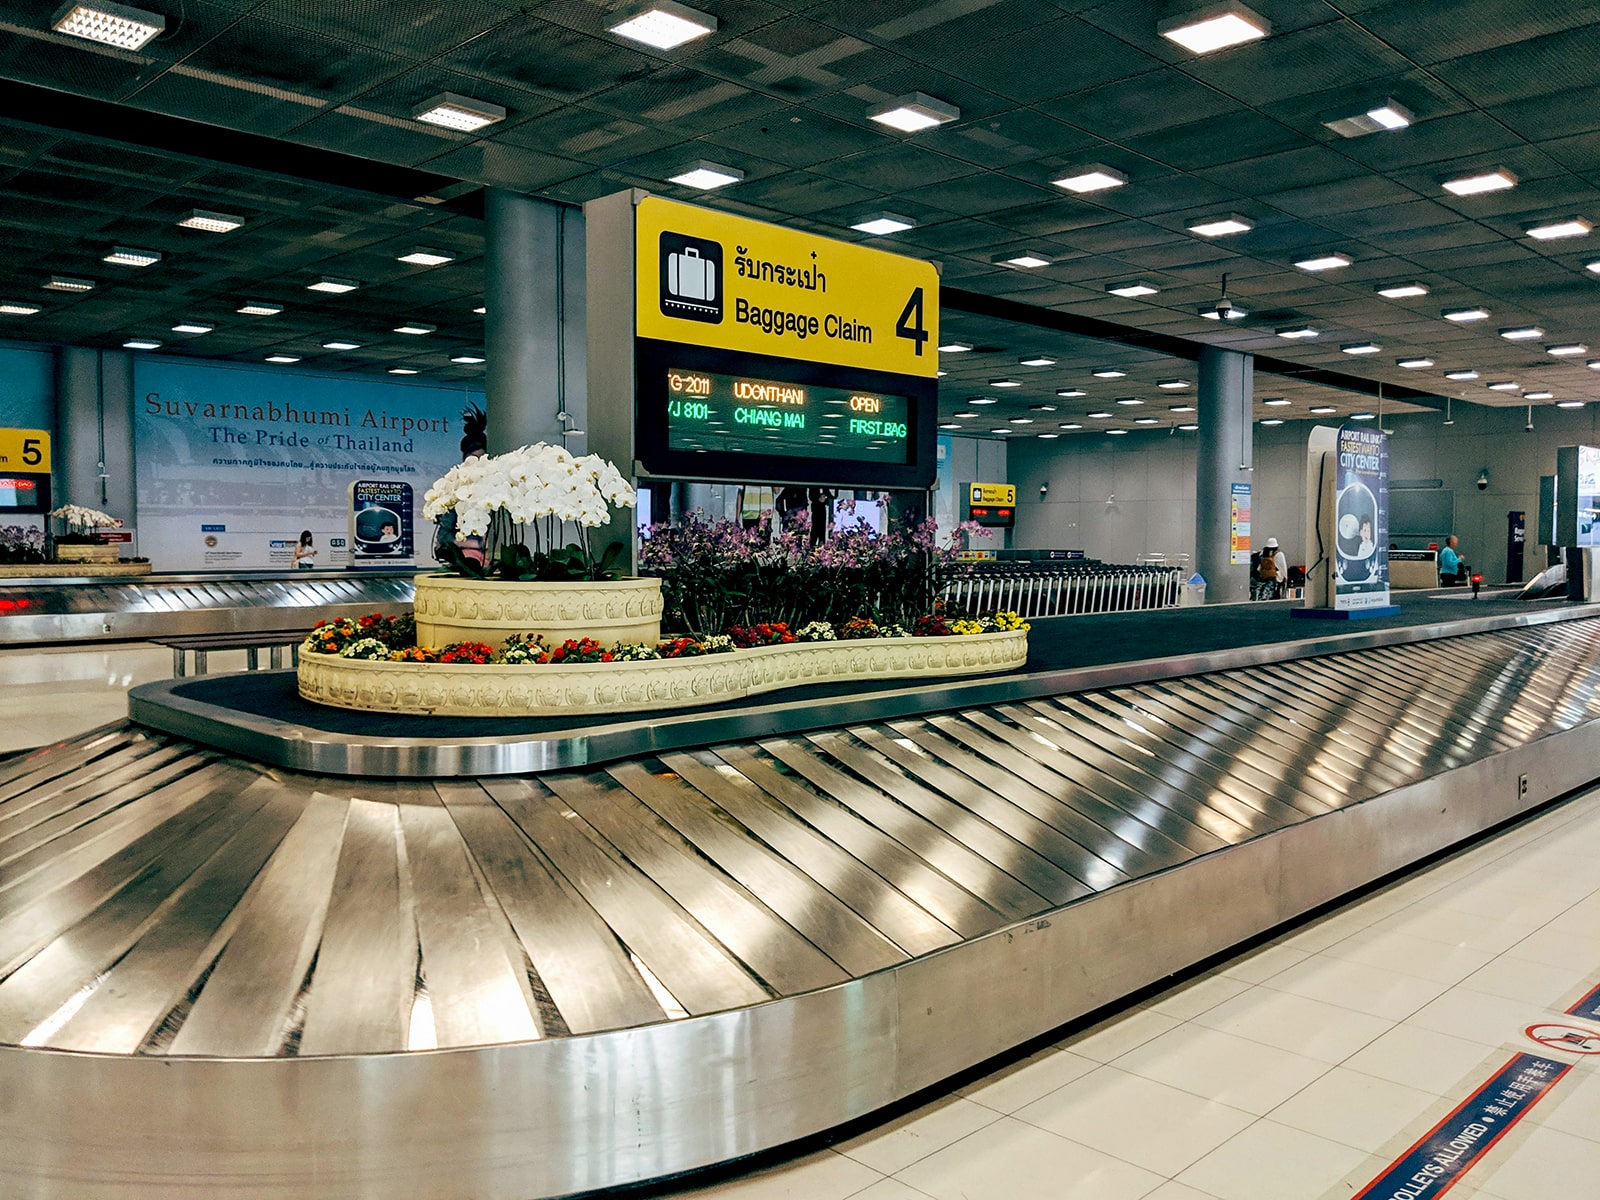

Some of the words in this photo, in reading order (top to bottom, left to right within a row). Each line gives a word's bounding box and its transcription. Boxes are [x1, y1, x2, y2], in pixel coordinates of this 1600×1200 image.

[734, 245, 826, 293] รับกระเป๋า
[735, 298, 819, 339] Baggage
[824, 314, 872, 344] Claim
[895, 286, 929, 357] 4
[667, 374, 683, 392] G
[734, 381, 804, 405] UDONTHANI
[145, 392, 350, 427] Suvarnabhumi
[361, 408, 449, 436] Airport
[683, 403, 709, 420] 8101
[849, 395, 880, 413] OPEN
[734, 407, 782, 427] CHIANG
[784, 413, 805, 428] MAI
[849, 418, 882, 436] FIRST
[883, 421, 907, 438] BAG
[1341, 430, 1360, 441] AIRPORT
[209, 427, 248, 444] The
[255, 430, 309, 448] Pride
[317, 435, 331, 446] of
[334, 434, 414, 453] Thailand
[1341, 440, 1361, 453] FASTEST
[22, 438, 42, 466] 5
[1340, 453, 1355, 468] CITY
[1356, 455, 1380, 470] CENTER
[357, 493, 374, 501] CITY
[374, 494, 402, 502] CENTER
[1007, 489, 1014, 503] 5
[1435, 1123, 1489, 1168] ALLOWED
